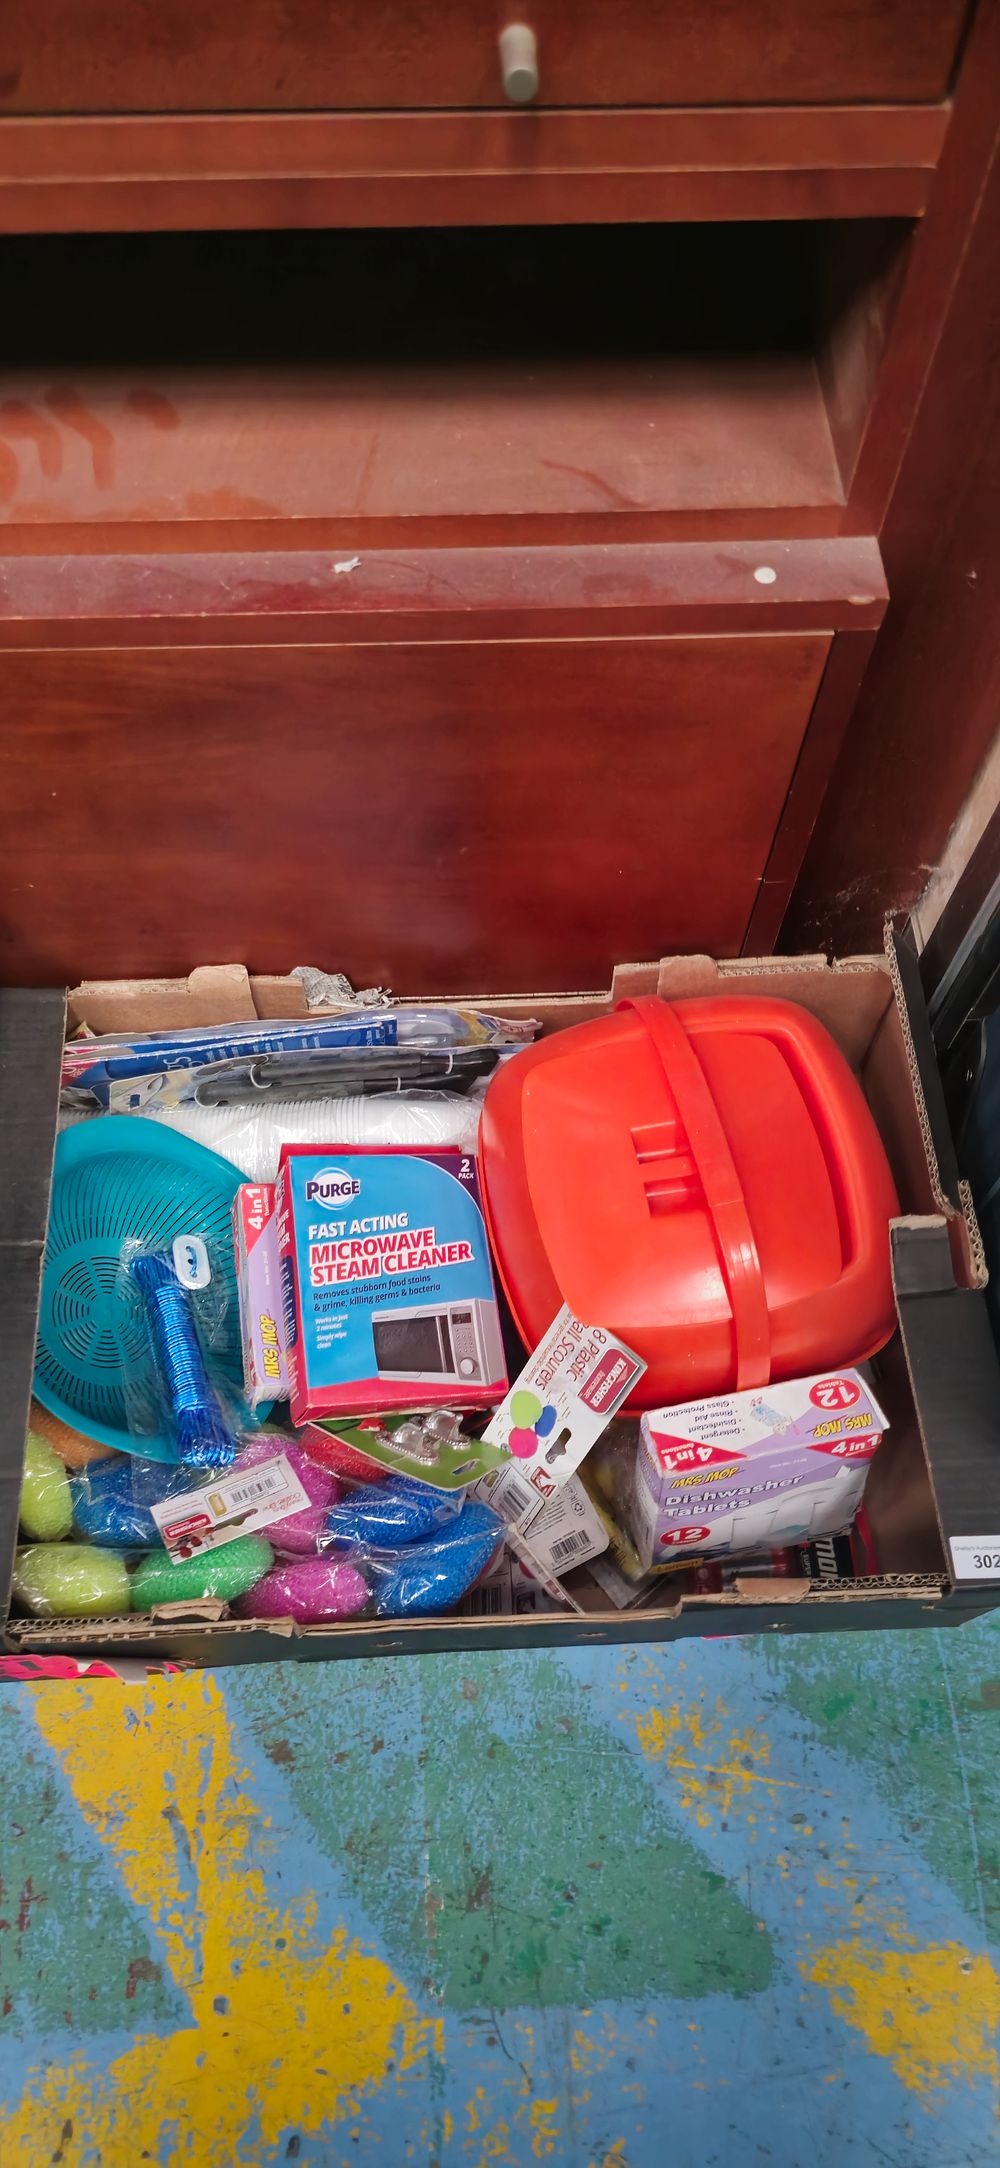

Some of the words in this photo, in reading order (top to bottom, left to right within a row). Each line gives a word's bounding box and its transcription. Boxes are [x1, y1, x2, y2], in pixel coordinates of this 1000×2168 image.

[461, 1159, 471, 1172] 2
[458, 1172, 474, 1180] PACK
[245, 1188, 261, 1198] 1
[307, 1181, 360, 1200] PURGE
[248, 1216, 263, 1230] 4
[308, 1221, 346, 1240] FAST
[350, 1212, 408, 1234] ACTING
[311, 1229, 434, 1265] MICROWAVE
[312, 1257, 380, 1285] STEAM
[384, 1243, 472, 1273] CLEANER
[313, 1288, 350, 1301] Removes
[351, 1283, 387, 1295] stubborn
[388, 1279, 406, 1291] food
[407, 1275, 431, 1285] stains
[313, 1304, 320, 1312] &
[322, 1300, 348, 1312] grime,
[349, 1295, 373, 1306] killing
[375, 1291, 400, 1303] germs
[401, 1289, 407, 1297] &
[409, 1283, 441, 1296] bacteria
[260, 1314, 278, 1346] MOP
[567, 1321, 590, 1343] all
[592, 1329, 607, 1344] 8
[263, 1348, 280, 1379] MRS
[535, 1336, 575, 1390] Scourers
[566, 1339, 600, 1382] Plastic
[590, 1357, 627, 1407] KINGFISHER
[707, 1400, 729, 1409] Glass
[816, 1386, 856, 1407] 12
[663, 1405, 705, 1418] Protection
[695, 1414, 709, 1422] Aid
[710, 1410, 733, 1418] Rinse
[688, 1419, 737, 1433] Disinfectant
[814, 1420, 842, 1438] MOP
[844, 1413, 873, 1431] MRS
[701, 1428, 740, 1440] Detergent
[831, 1441, 847, 1453] 4
[867, 1434, 879, 1446] 1
[663, 1455, 678, 1470] 1
[696, 1447, 713, 1462] 4
[671, 1475, 702, 1488] MRS
[705, 1467, 739, 1482] MOP
[665, 1475, 804, 1506] Dishwasher
[663, 1499, 751, 1517] Tablets
[668, 1529, 703, 1541] 12
